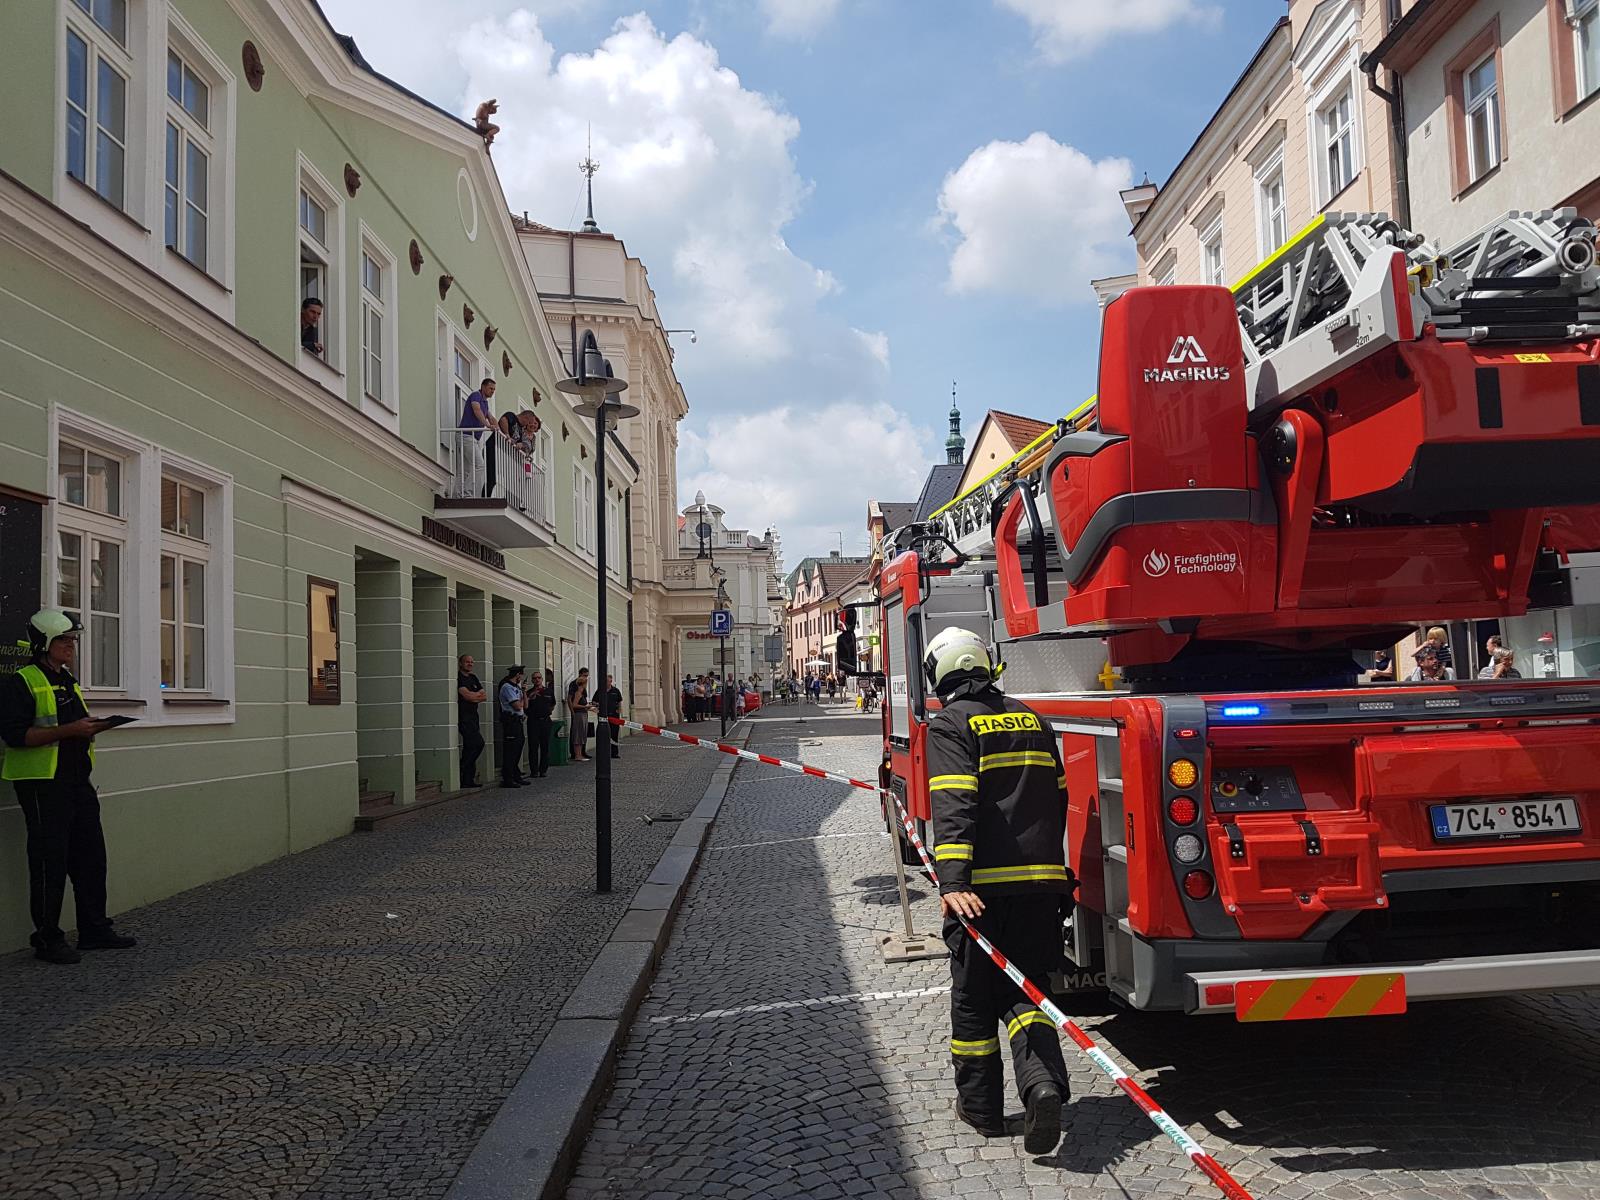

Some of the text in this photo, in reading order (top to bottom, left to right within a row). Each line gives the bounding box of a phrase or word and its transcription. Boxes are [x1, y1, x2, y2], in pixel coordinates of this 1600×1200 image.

[1143, 366, 1230, 383] MAGIRUS
[1174, 552, 1236, 566] Firefighting
[1174, 562, 1236, 574] Technology
[715, 613, 726, 628] P
[973, 714, 1040, 732] HASIČI
[1451, 802, 1567, 833] 7C4 8541
[1437, 824, 1449, 834] CZ
